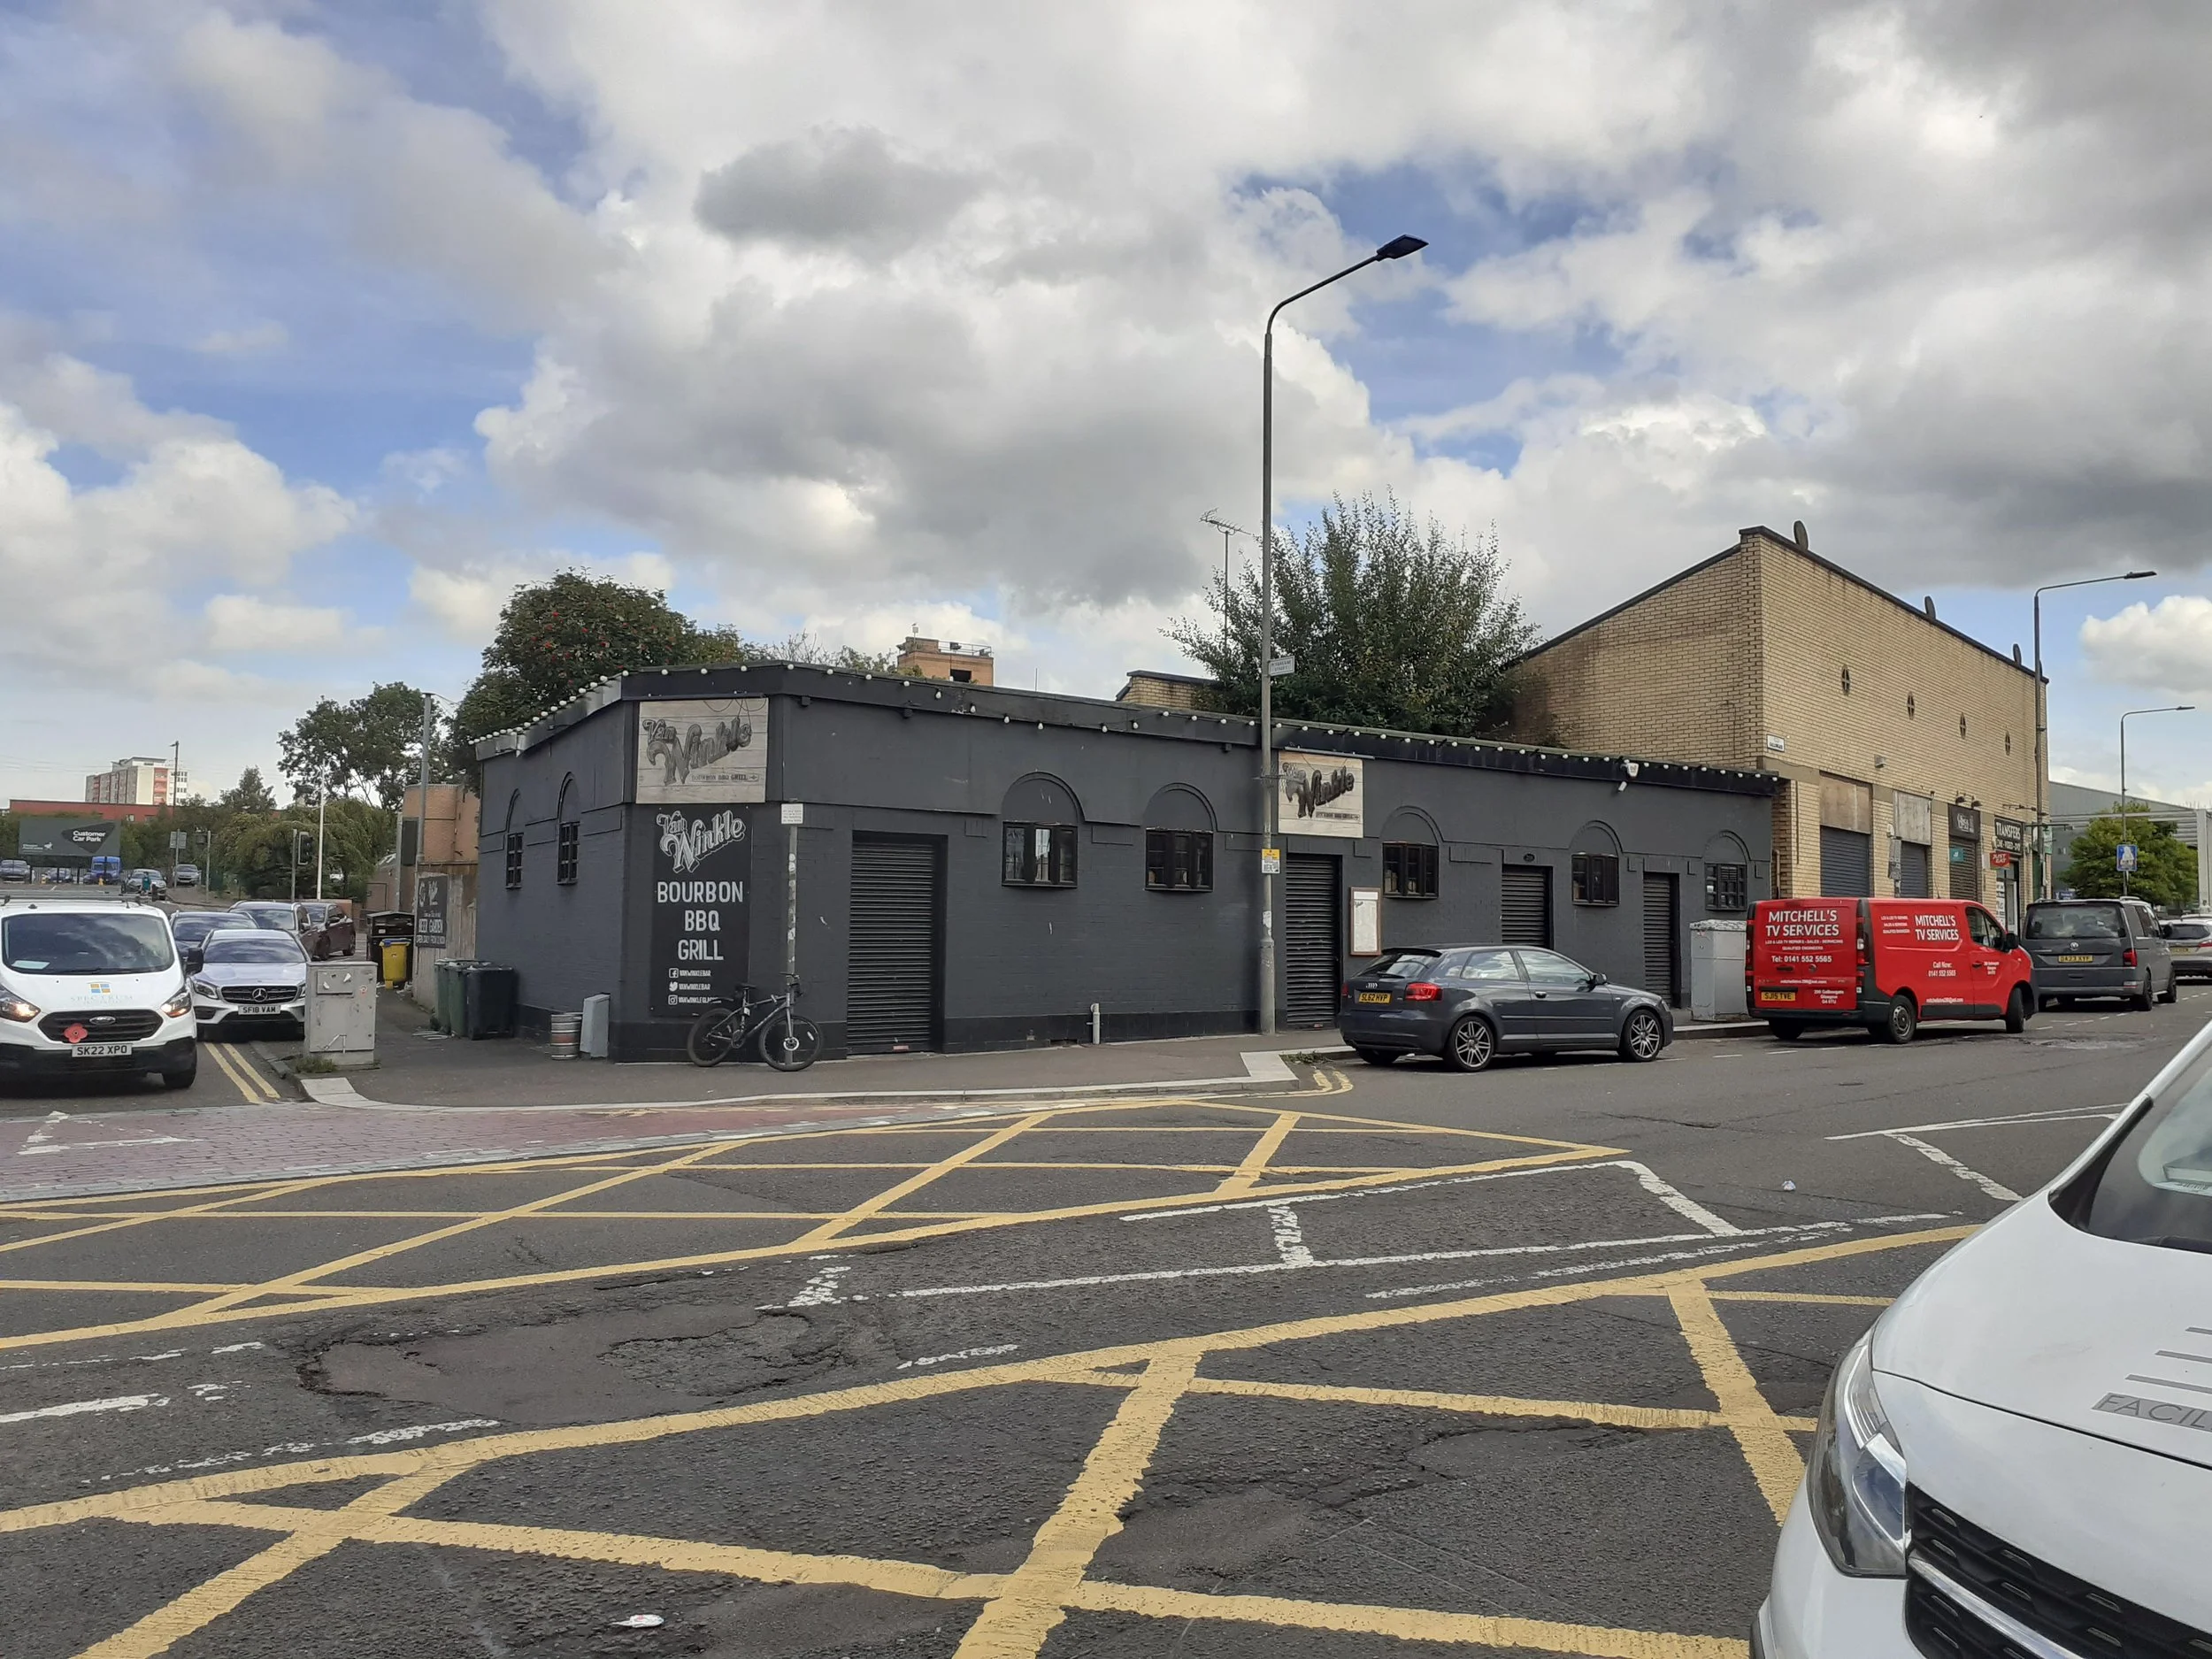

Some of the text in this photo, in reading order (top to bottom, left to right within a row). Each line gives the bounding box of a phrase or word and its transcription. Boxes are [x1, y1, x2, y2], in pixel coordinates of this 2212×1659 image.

[642, 718, 677, 744] Van
[647, 717, 752, 787] Winkle
[657, 810, 688, 835] Van
[659, 810, 746, 873] Winkle
[657, 881, 743, 902] BOURBON
[685, 910, 721, 932] BBQ
[1769, 910, 1838, 923] MITCHELL'S
[1915, 915, 1956, 926] MITCHELL'S
[1765, 925, 1839, 936] TV SERVICES
[1916, 929, 1959, 941] TV SERVICES
[678, 940, 724, 961] GRILL
[1376, 994, 1387, 1002] HVP
[77, 1045, 127, 1056] SK22 XPO
[2097, 1394, 2212, 1430] FACIL
